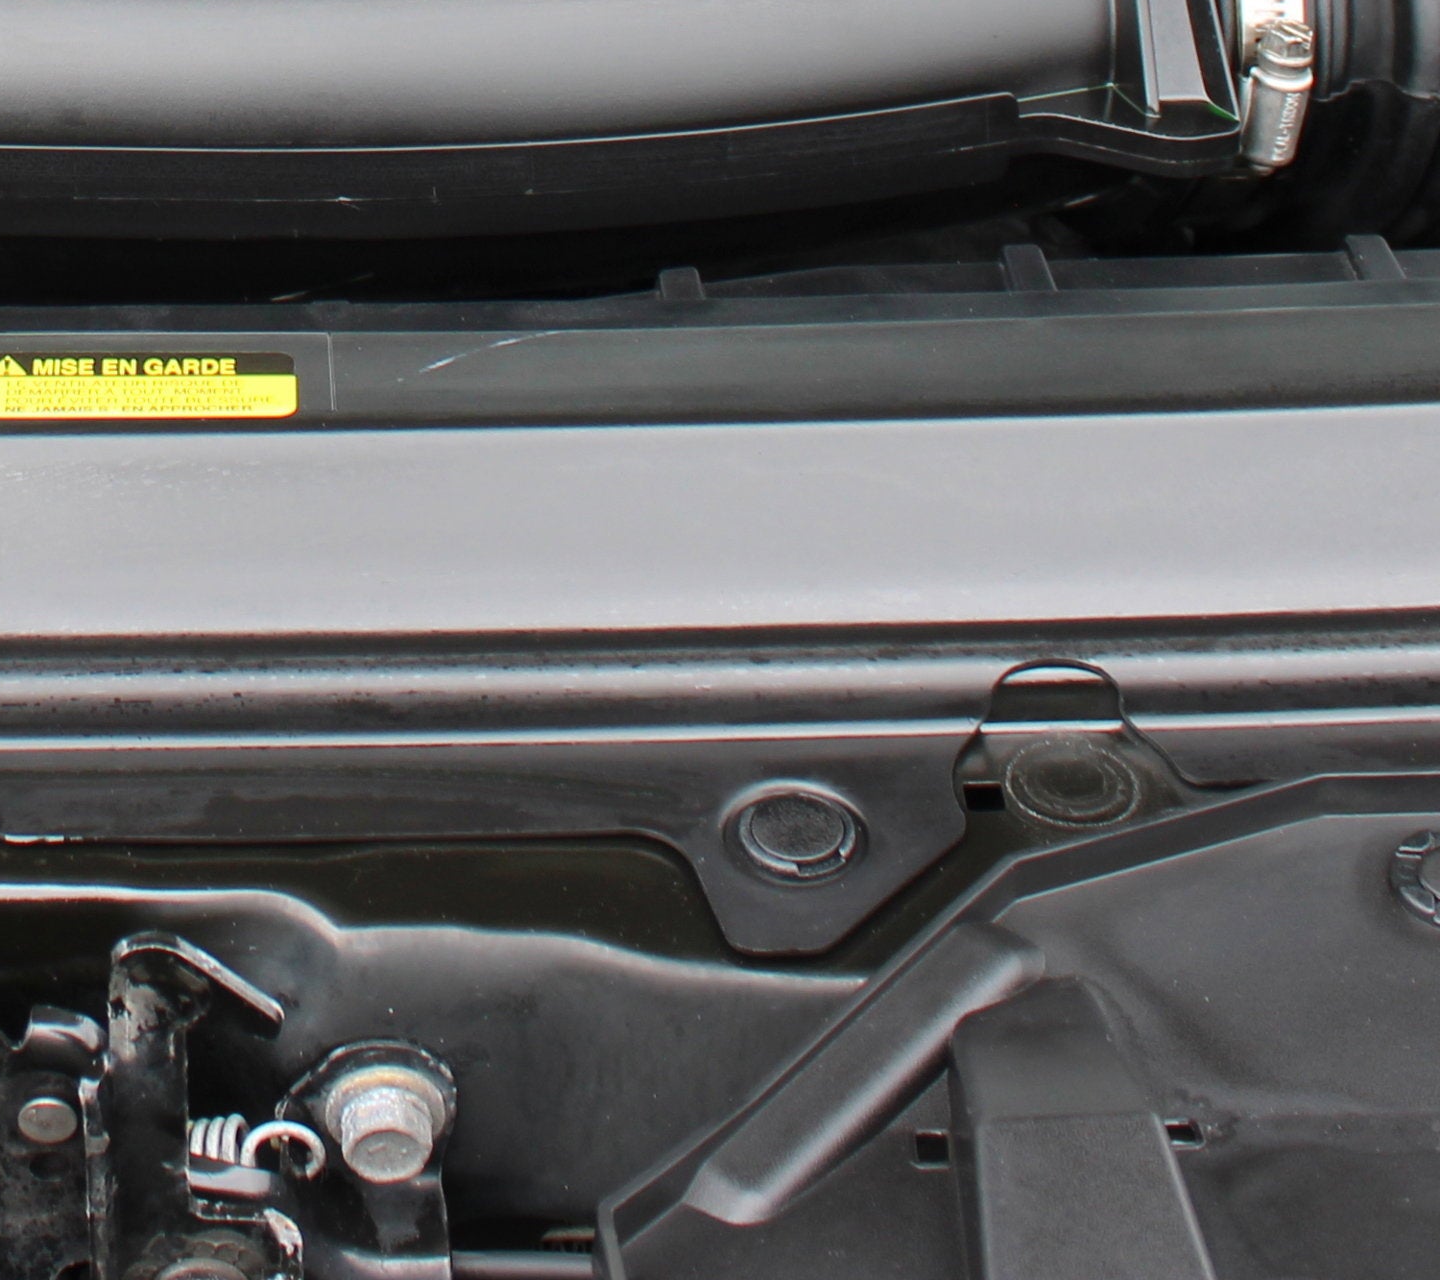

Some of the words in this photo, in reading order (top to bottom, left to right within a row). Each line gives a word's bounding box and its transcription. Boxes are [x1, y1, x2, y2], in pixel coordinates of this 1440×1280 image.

[32, 358, 95, 376] MISE
[101, 358, 140, 376] EN
[143, 358, 237, 376] GARDE
